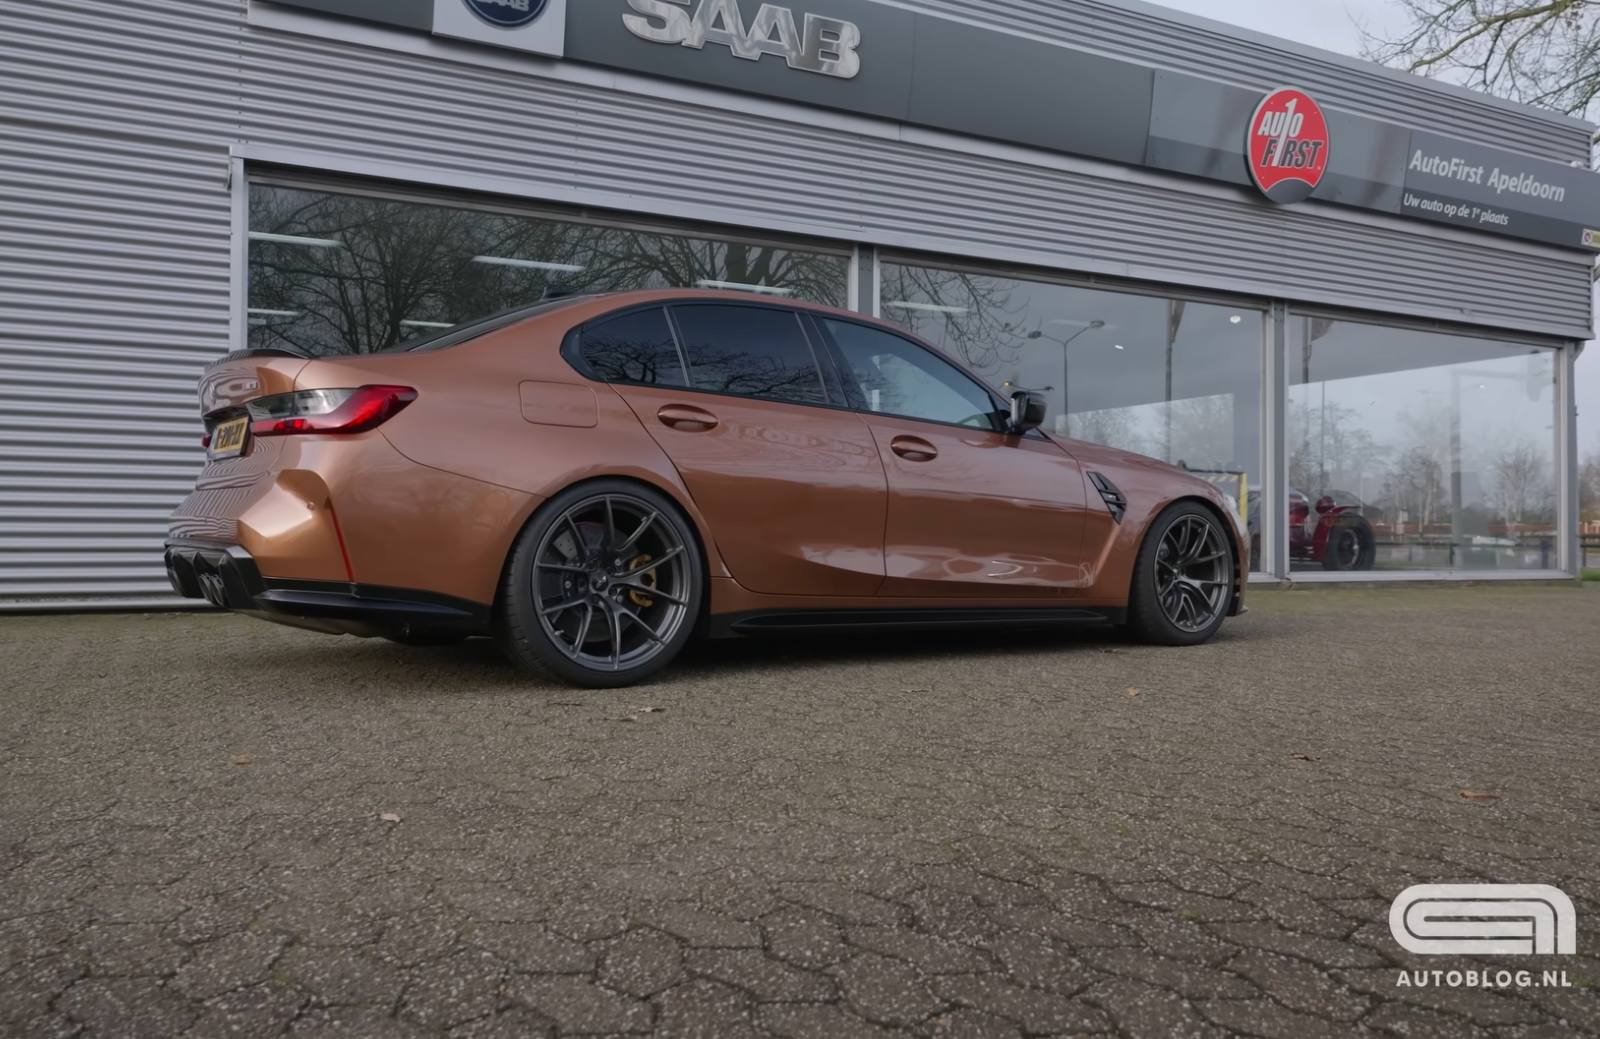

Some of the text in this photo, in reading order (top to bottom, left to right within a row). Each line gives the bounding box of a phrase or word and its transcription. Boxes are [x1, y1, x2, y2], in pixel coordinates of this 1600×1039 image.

[622, 0, 861, 79] SAAB
[1409, 149, 1566, 203] AutoFirst Apeldoorn
[1403, 192, 1421, 207] Uw
[1420, 199, 1443, 213] auto
[1444, 203, 1456, 217] op
[1457, 203, 1470, 218] de
[1480, 209, 1509, 226] plaats
